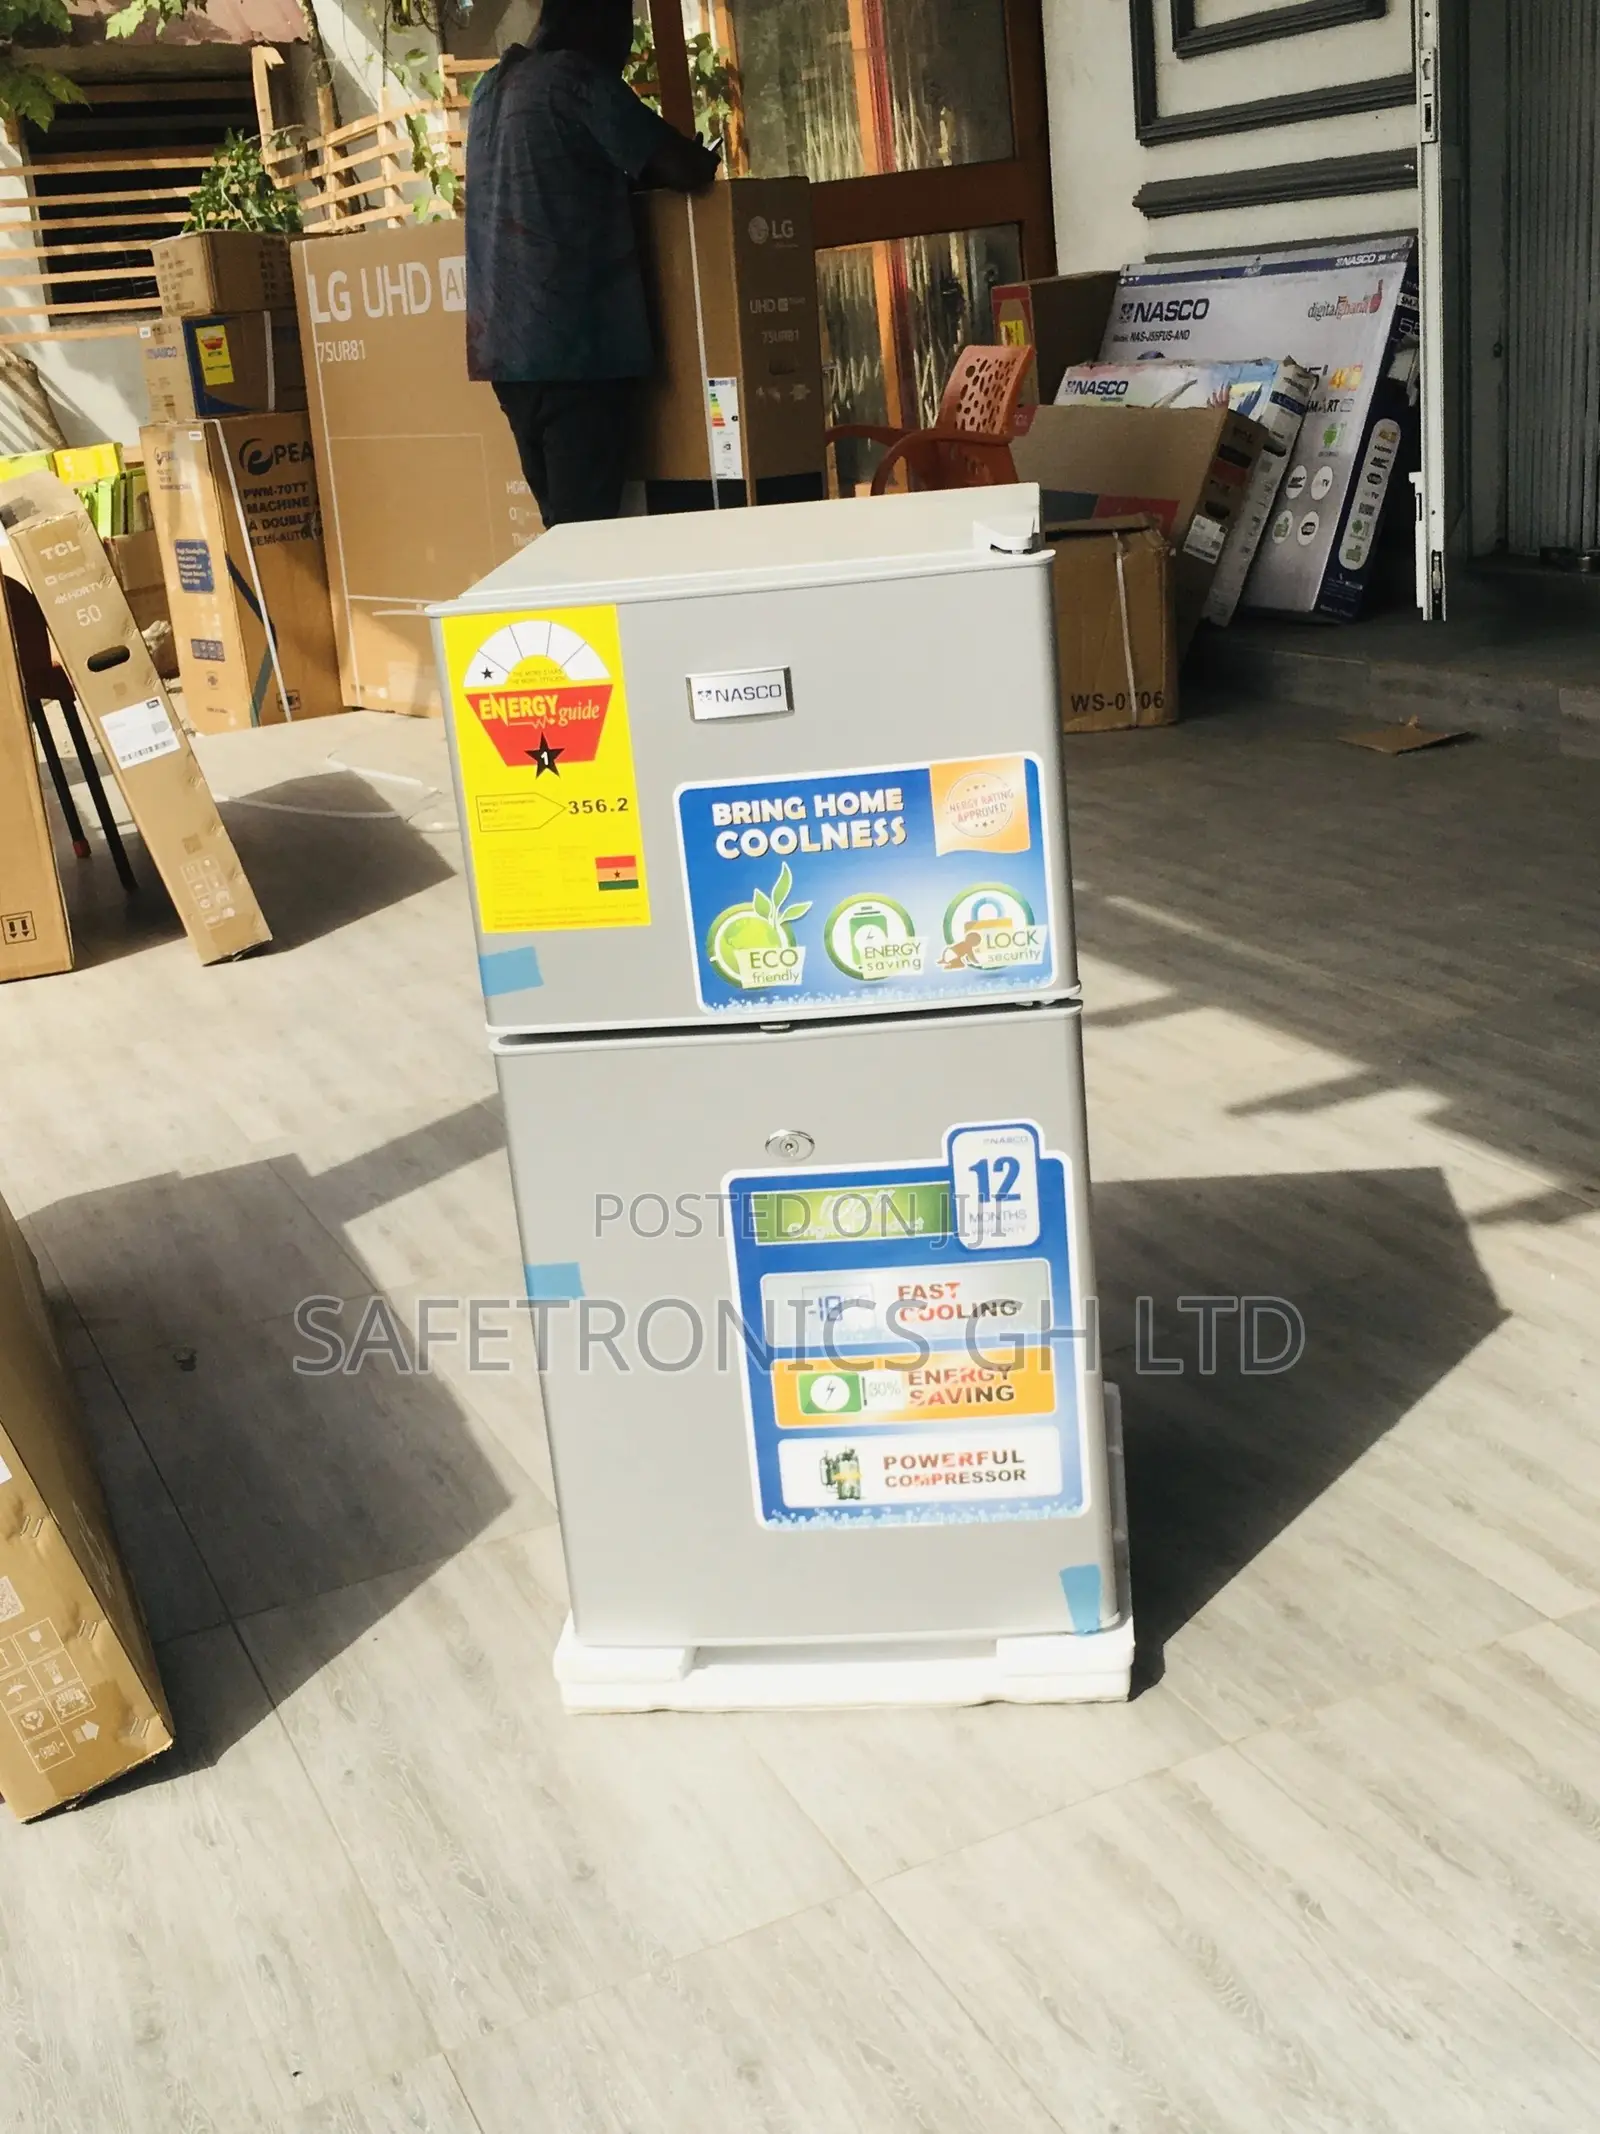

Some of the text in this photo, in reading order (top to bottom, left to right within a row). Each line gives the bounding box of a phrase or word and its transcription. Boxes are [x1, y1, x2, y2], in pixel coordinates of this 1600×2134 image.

[772, 219, 795, 240] LG
[1343, 253, 1377, 266] NASCO
[308, 269, 352, 324] LG
[360, 262, 432, 318] UHD
[750, 298, 776, 314] UHD
[1133, 298, 1210, 323] NASCO
[316, 339, 367, 364] 75UR81
[1074, 380, 1128, 396] NASCO
[246, 495, 310, 515] MACHINE
[40, 540, 81, 560] TCL
[76, 604, 102, 627] 50
[715, 683, 782, 703] NASCO
[479, 693, 600, 727] ENERGY guide
[540, 752, 549, 766] 1
[568, 797, 629, 815] 356.2
[712, 787, 905, 827] BRING HOME
[945, 798, 978, 814] NERGY
[957, 802, 1007, 822] APPROVED
[715, 816, 907, 860] COOLNESS
[986, 930, 1039, 950] LOCK
[750, 948, 799, 969] ECO
[864, 942, 921, 960] ENERGY
[988, 948, 1041, 963] security
[867, 958, 922, 973] saving
[752, 970, 800, 985] friendly
[968, 1156, 1022, 1204] 12
[969, 1208, 1028, 1224] MONTHS
[898, 1282, 961, 1301] FAST
[900, 1299, 1019, 1323] COOLING
[908, 1364, 1013, 1387] ENERGY
[909, 1385, 1015, 1407] SAVING
[883, 1448, 1026, 1471] POWERFUL
[884, 1468, 1028, 1489] COMPRESSOR
